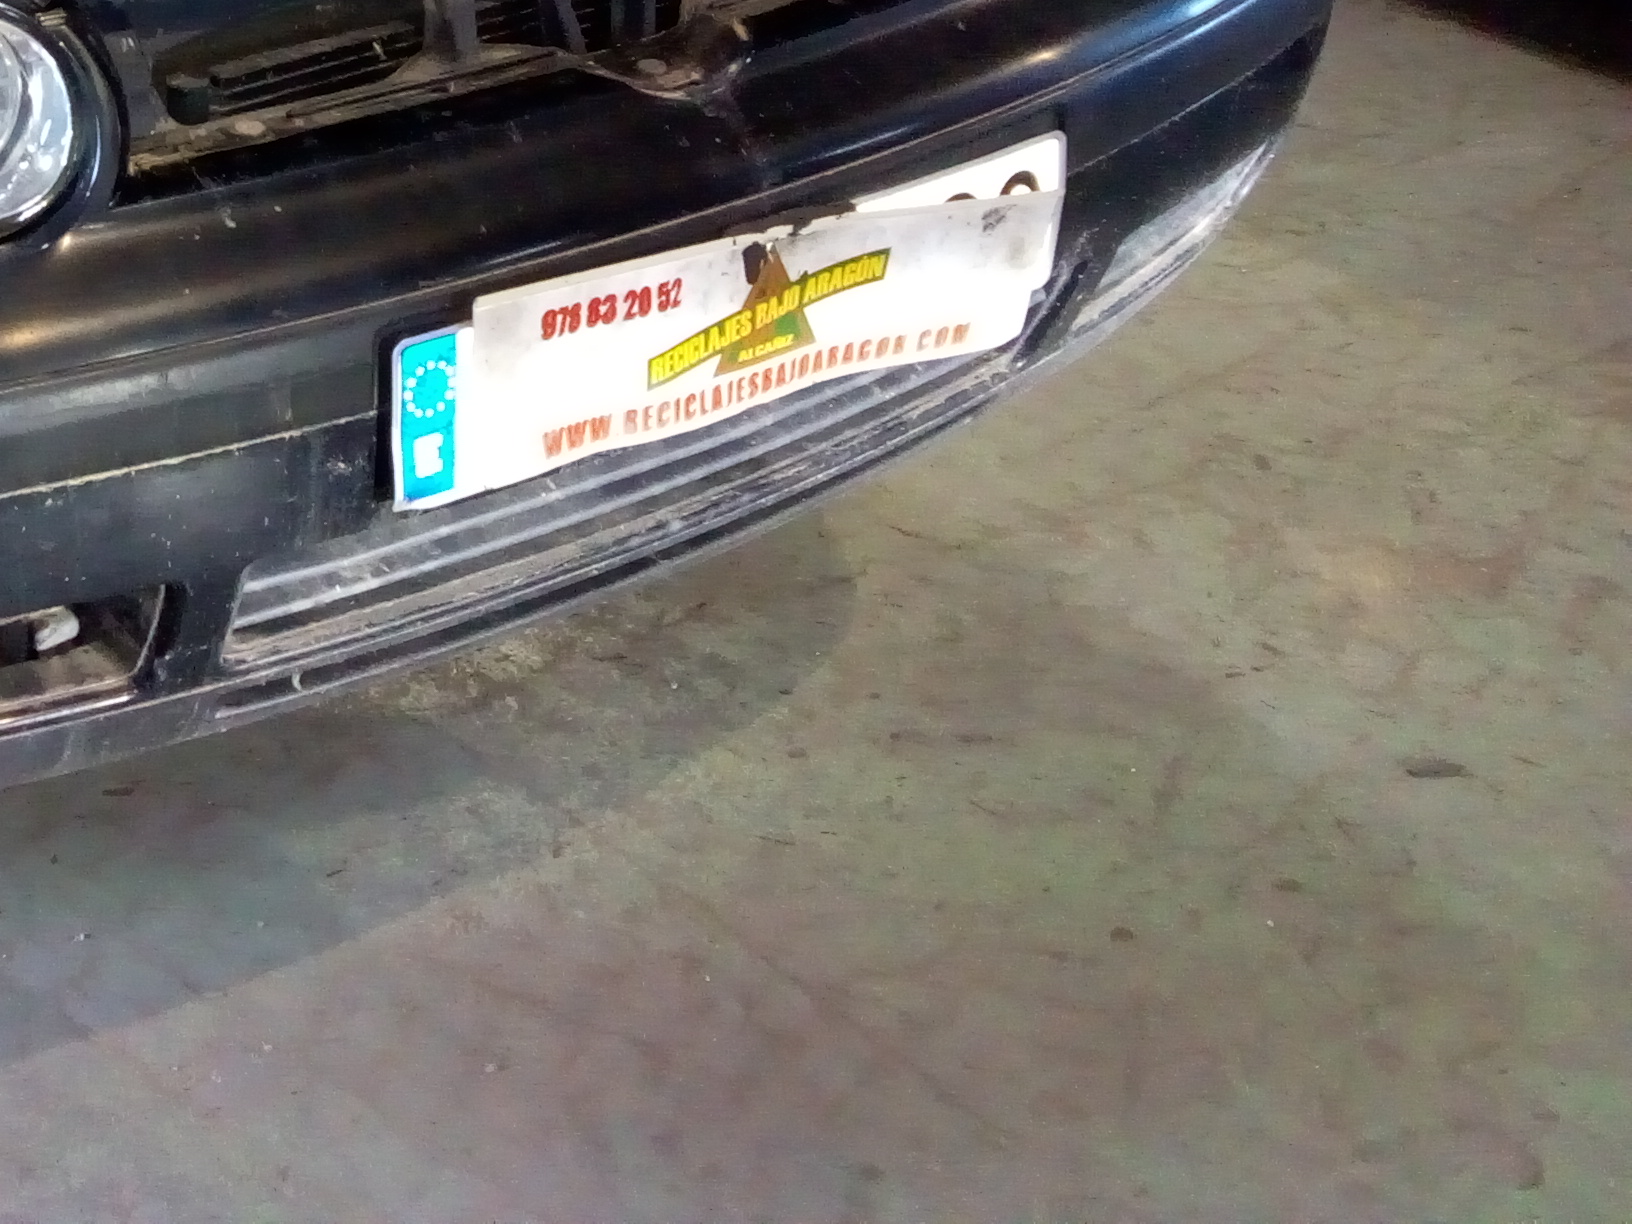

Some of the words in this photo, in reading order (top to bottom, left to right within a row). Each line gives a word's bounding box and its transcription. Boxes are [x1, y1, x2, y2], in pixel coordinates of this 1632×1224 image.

[541, 302, 582, 340] 978
[586, 293, 617, 327] 83
[623, 286, 651, 322] 20
[657, 277, 682, 312] 52
[651, 309, 753, 386] RECICLAJES
[755, 284, 801, 330] BAJO
[542, 321, 971, 460] WWW.RECICLAJESBAJOARAGONCOM
[413, 431, 444, 478] E
